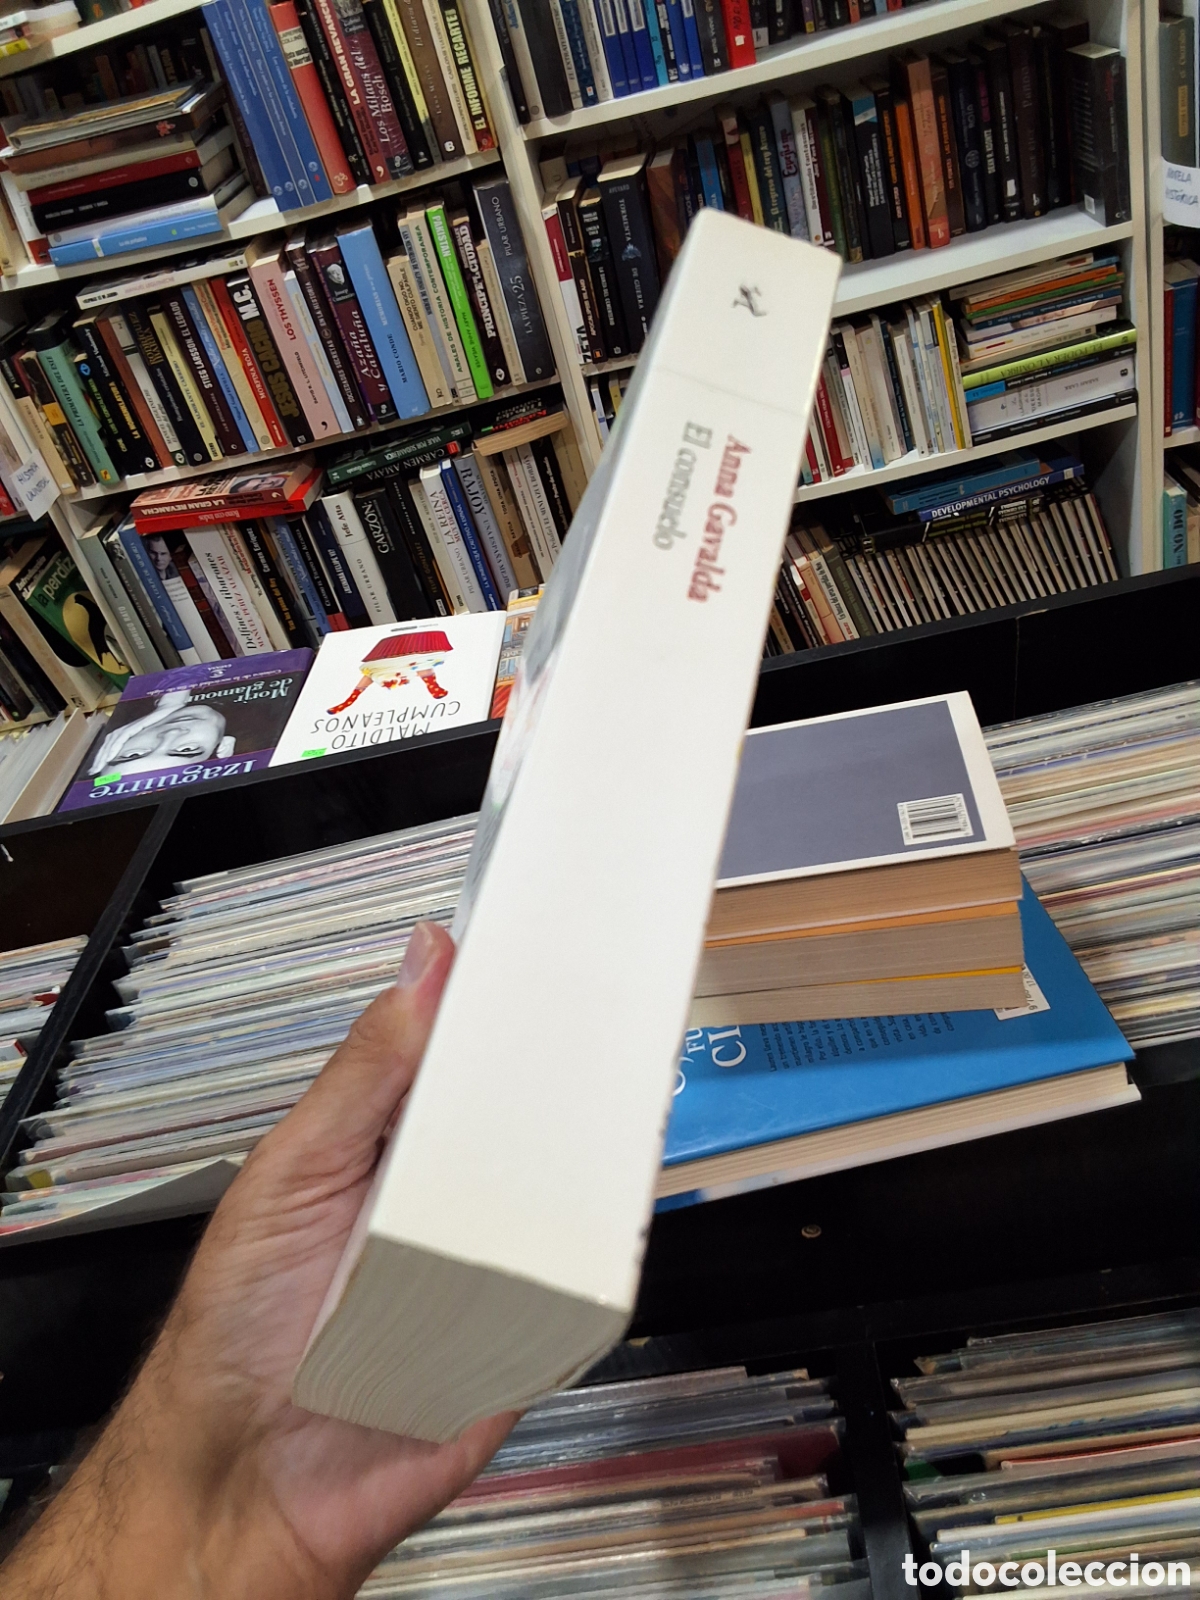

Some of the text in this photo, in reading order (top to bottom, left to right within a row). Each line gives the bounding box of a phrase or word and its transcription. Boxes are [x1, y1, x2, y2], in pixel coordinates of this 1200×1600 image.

[336, 54, 356, 88] GRAN
[460, 66, 483, 115] INFORME
[349, 88, 361, 105] LA
[351, 49, 390, 144] Los Milans del
[371, 73, 393, 114] Bosch
[473, 116, 487, 130] EL
[756, 125, 779, 215] El regreso del rey Arturo
[431, 214, 451, 257] PAKISTAN
[491, 195, 512, 256] PILAR URBANO
[617, 198, 633, 241] TORMENTA
[399, 267, 423, 329] ME SIENTO CULPABLE
[401, 287, 410, 305] DIGO
[458, 224, 497, 338] PRINCIPE CIUDAD
[631, 267, 645, 309] DE GUERRA
[168, 299, 187, 328] LEGADO
[266, 278, 296, 340] LOS THYSSEN
[406, 306, 418, 331] CUANDO
[434, 295, 449, 329] HISTORIA
[509, 274, 533, 334] LA PIEZA 25
[180, 326, 191, 337] EL
[243, 316, 282, 373] CACHO
[303, 280, 355, 403] SOCIEDADES SECRETAS EN LA HISTORIA
[351, 309, 388, 392] y Cataluña
[445, 331, 453, 341] DE
[1088, 342, 1103, 352] EL
[240, 347, 266, 399] MORFINA ROJA
[350, 331, 372, 378] Azaña
[386, 333, 408, 383] MARIO CONDE
[449, 343, 463, 373] ANALES
[1043, 357, 1052, 366] A
[1053, 345, 1088, 364] PODER
[53, 370, 63, 383] DEL
[198, 368, 213, 389] STIEG
[1064, 376, 1098, 390] SARAH LARK
[59, 383, 80, 419] PRIMAVERA
[75, 418, 84, 427] LA
[132, 429, 140, 439] LA
[416, 439, 427, 448] POR
[365, 447, 445, 481] CARMEN AMAYA
[460, 466, 484, 517] RAJOY
[473, 474, 489, 503] MARIANO
[653, 421, 713, 551] El consuelo
[930, 491, 997, 519] DEVELOPMENTAL
[997, 476, 1050, 498] PSYCHOLOGY
[141, 498, 224, 516] LA GRAN REVANCHA
[198, 513, 213, 522] todos
[224, 509, 240, 519] Bono
[333, 504, 353, 538] Jefe Atta
[426, 490, 456, 546] LA REINA
[436, 488, 461, 542] MUY DE CERCA
[687, 433, 752, 603] Anna Gavalda
[244, 526, 270, 573] Carmen Enríquez
[482, 518, 512, 588] UNA ESPAÑA MEJOR
[32, 553, 77, 607] la perdiz
[355, 558, 381, 612] PILAR URBANO
[451, 546, 475, 594] PILAR URBANO
[202, 550, 259, 652] Delfines y tiburones
[267, 576, 296, 630] Tras los pasos del Rey
[117, 604, 145, 651] RODRIGO RATO
[246, 617, 265, 647] MANUEL
[184, 674, 294, 707] de glamour
[237, 676, 293, 703] Morir
[310, 701, 461, 735] CUMPLEAÑOS
[331, 720, 431, 750] MALDITO
[90, 759, 257, 798] Izaguirre
